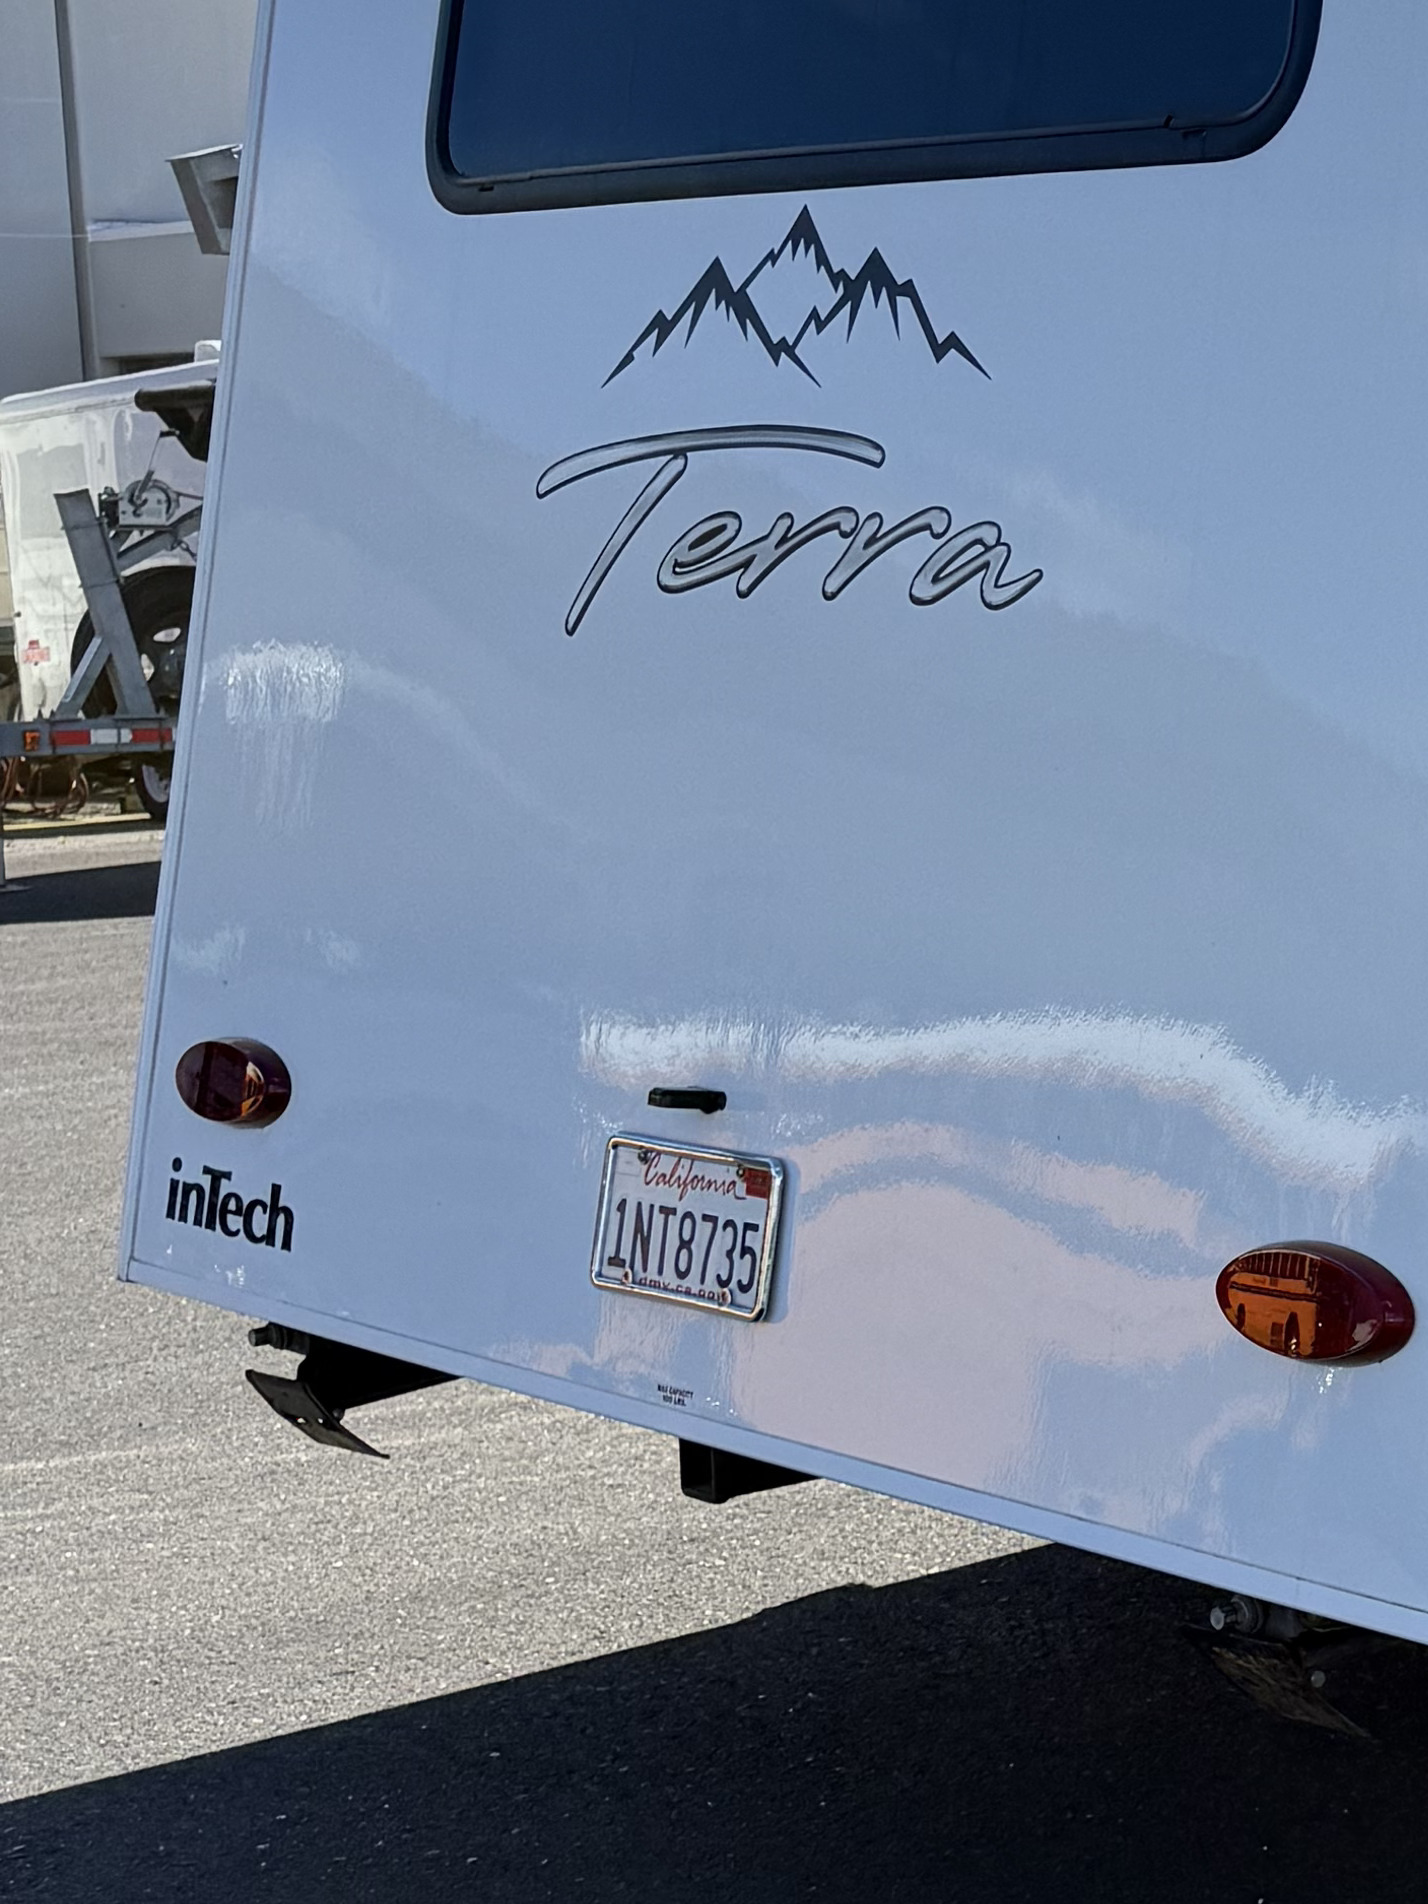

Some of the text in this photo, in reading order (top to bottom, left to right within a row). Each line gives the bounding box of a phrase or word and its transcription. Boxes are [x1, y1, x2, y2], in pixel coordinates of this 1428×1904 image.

[536, 424, 1044, 636] Terra
[165, 1157, 295, 1253] inTech
[643, 1152, 746, 1202] California
[607, 1198, 760, 1294] 1NT8735
[638, 1276, 722, 1301] dmv.ca.go
